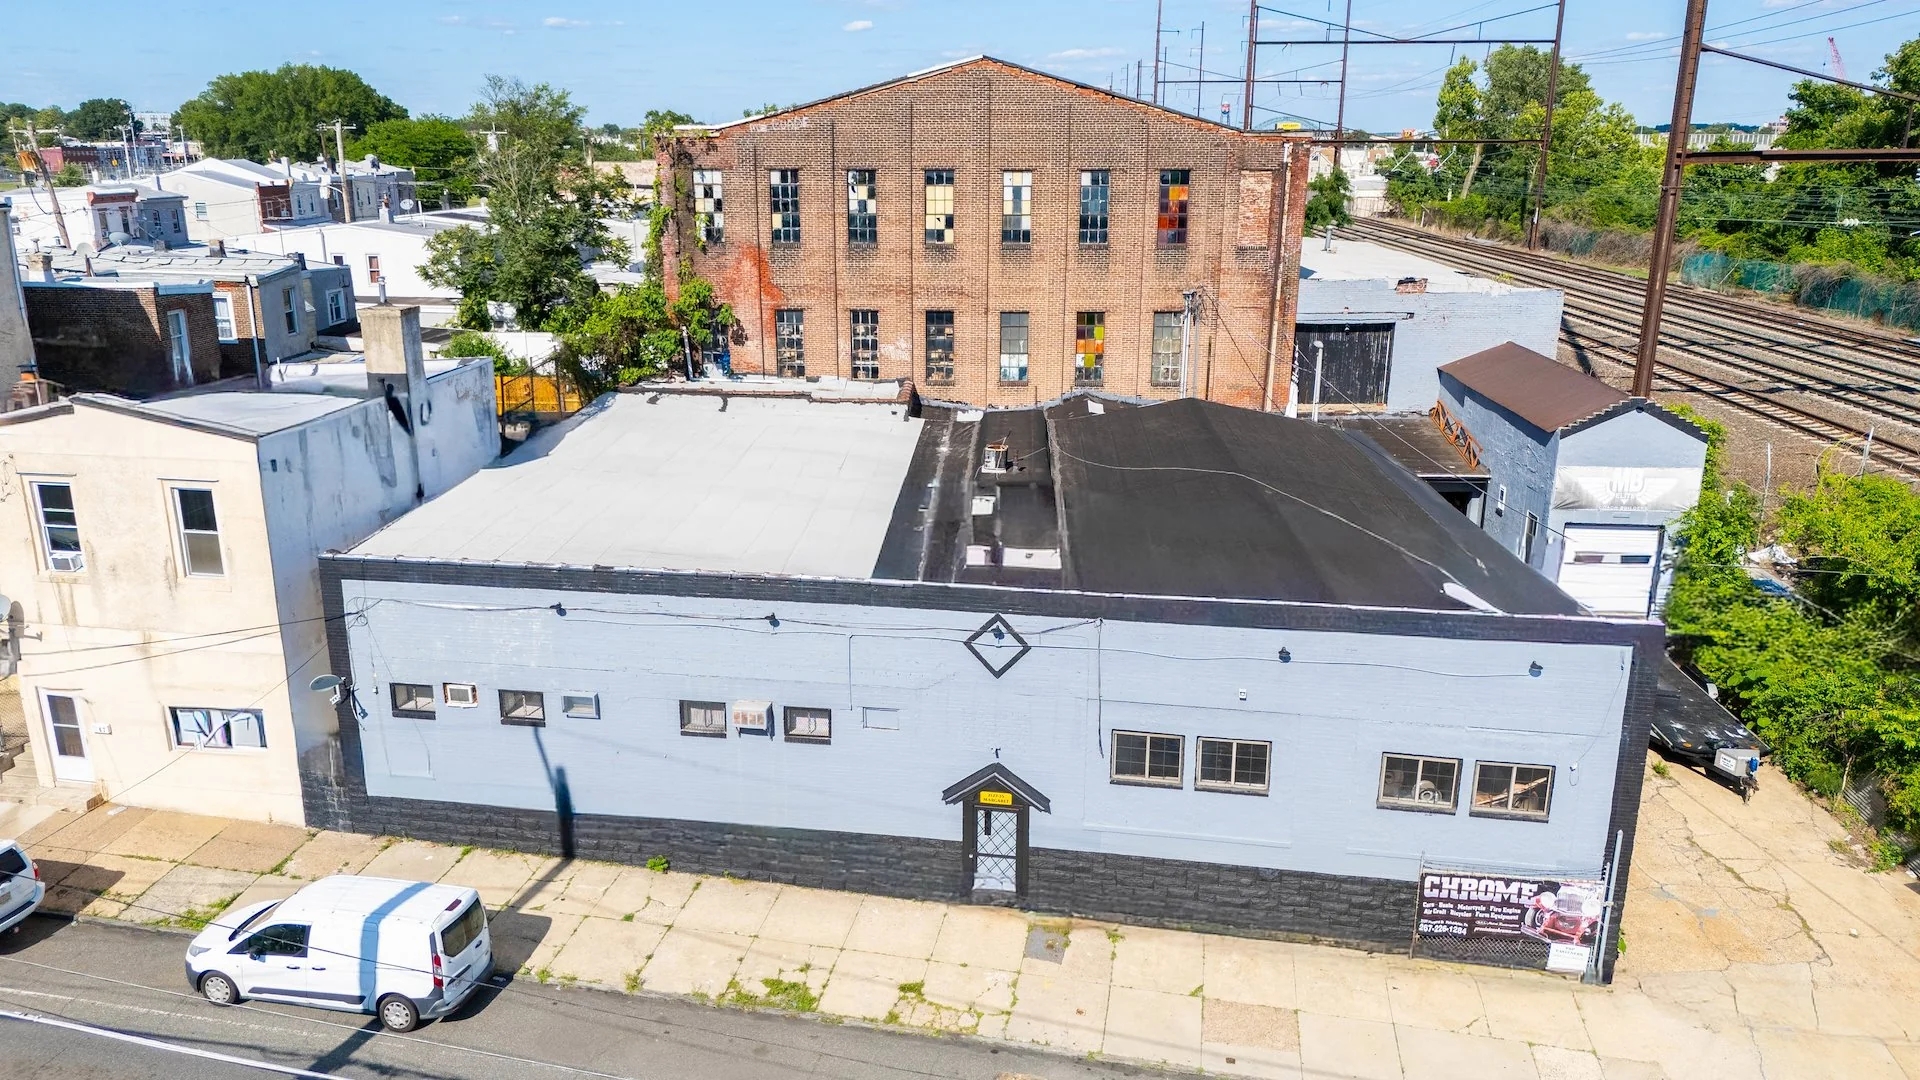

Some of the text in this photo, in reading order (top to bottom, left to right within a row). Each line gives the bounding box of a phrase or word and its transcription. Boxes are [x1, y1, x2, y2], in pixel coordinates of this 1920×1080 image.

[1424, 876, 1538, 905] CHROME
[1450, 909, 1472, 917] Bicycles
[1490, 912, 1518, 920] Equipment
[1502, 906, 1521, 915] Engine
